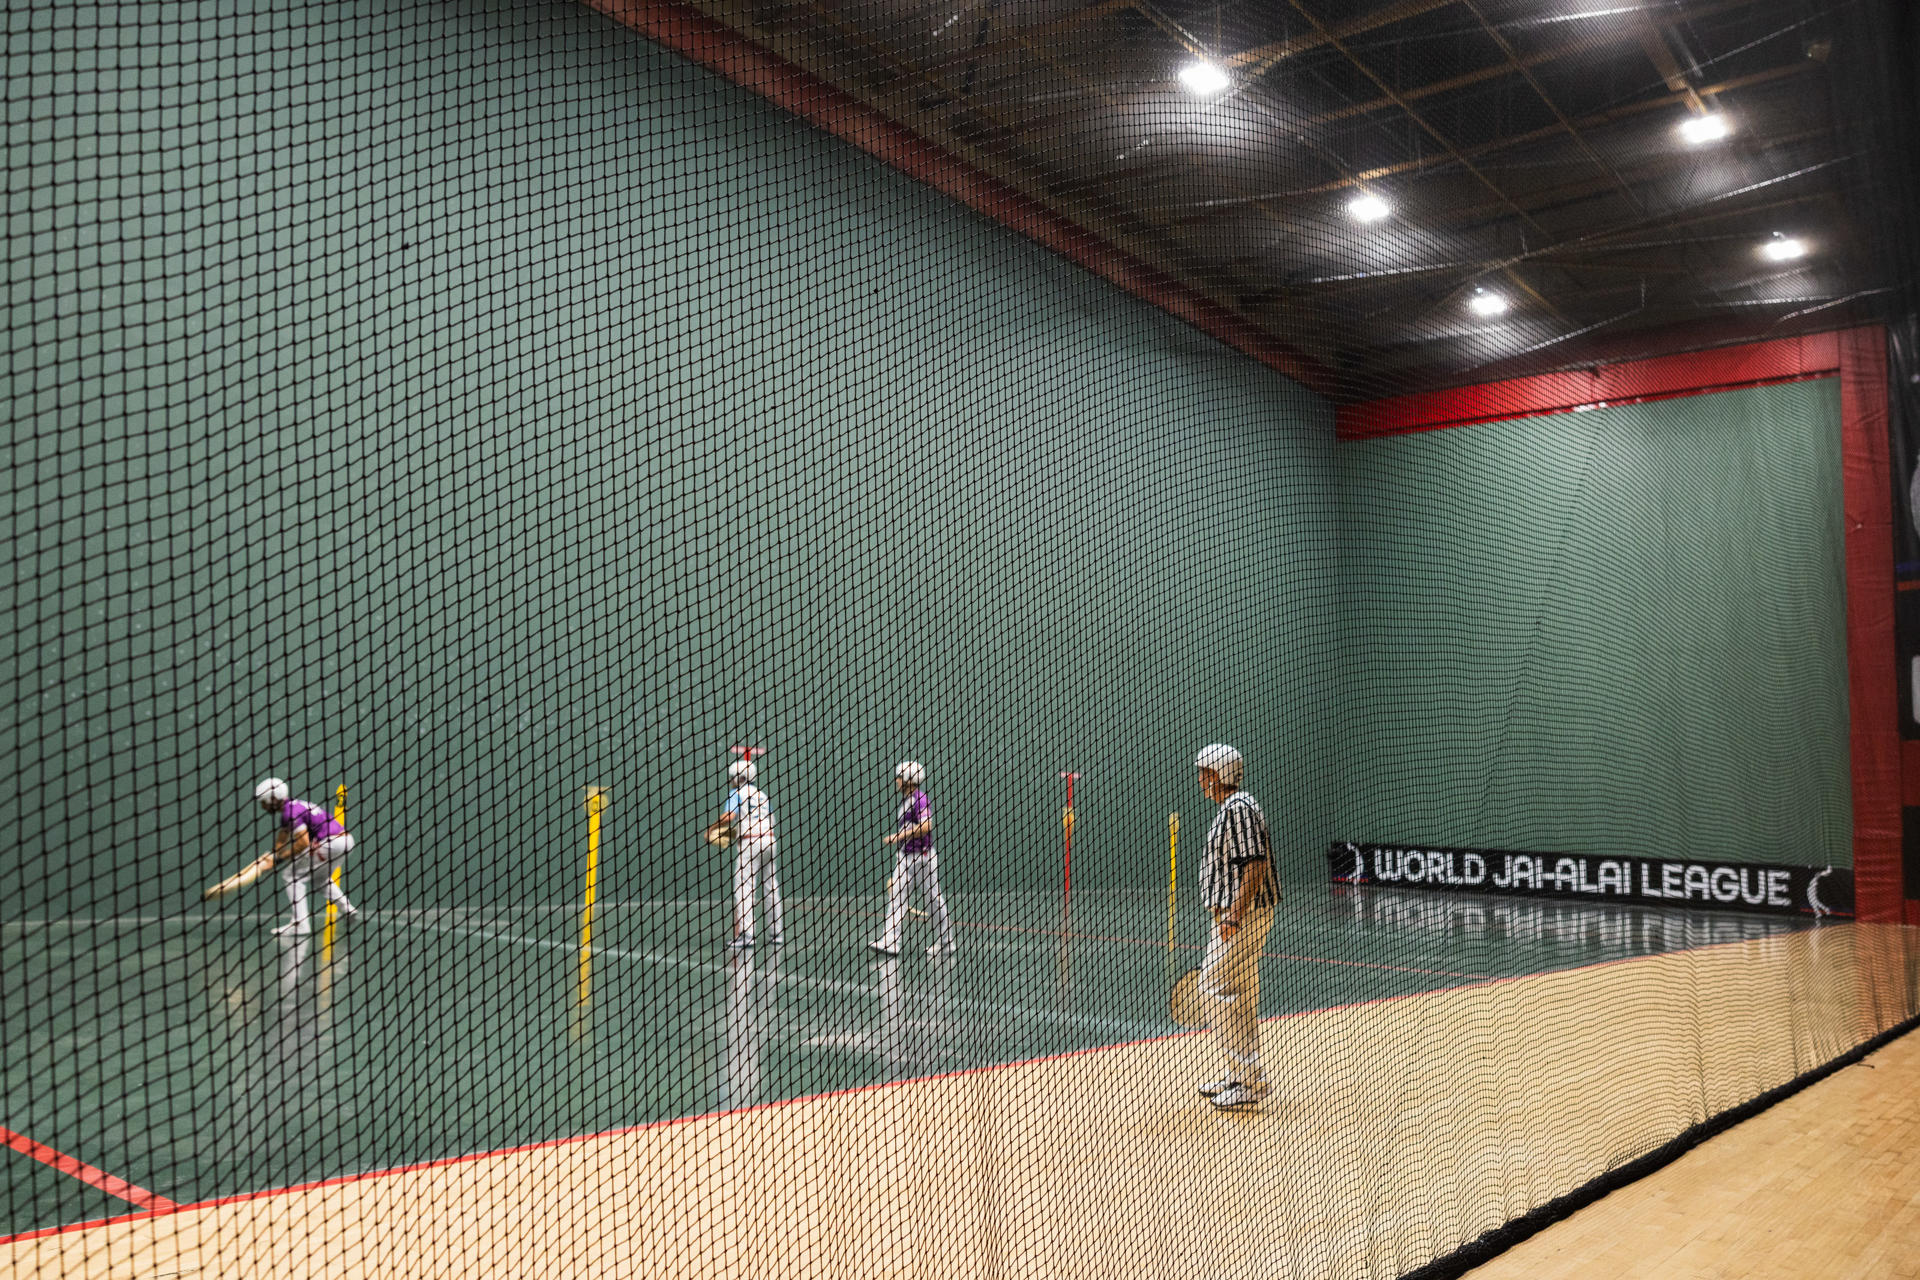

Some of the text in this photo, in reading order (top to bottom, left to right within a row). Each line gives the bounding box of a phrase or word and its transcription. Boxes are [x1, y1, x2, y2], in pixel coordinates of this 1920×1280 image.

[1374, 849, 1791, 906] WORLD JAI-ALAI LEAGUE
